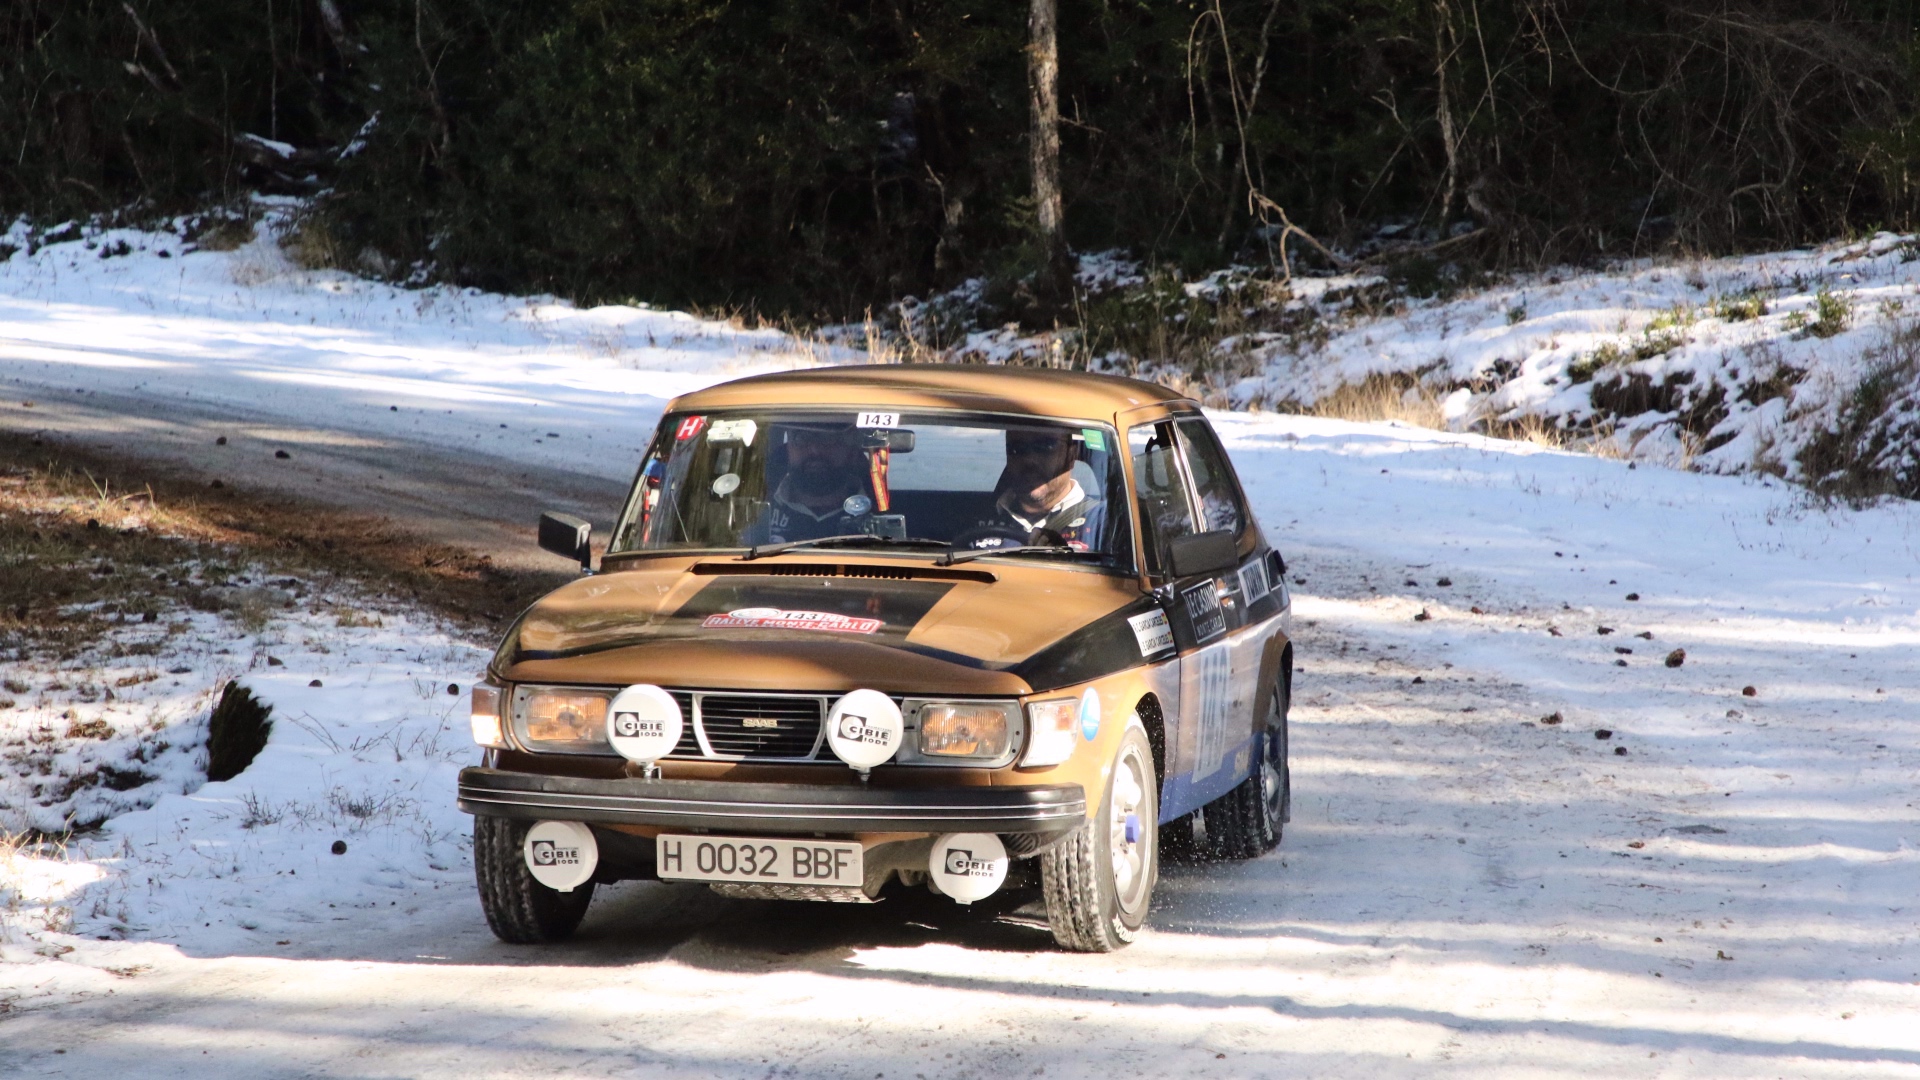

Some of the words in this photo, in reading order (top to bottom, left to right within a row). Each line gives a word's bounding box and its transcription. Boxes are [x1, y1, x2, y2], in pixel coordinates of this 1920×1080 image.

[865, 414, 892, 426] 143
[1184, 593, 1198, 619] LE
[1192, 584, 1219, 616] CASINO
[708, 616, 760, 626] RALLYE
[785, 612, 818, 620] 143
[742, 718, 778, 727] SAAB
[663, 840, 682, 872] H
[697, 842, 778, 877] 0032
[793, 846, 853, 880] BBF
